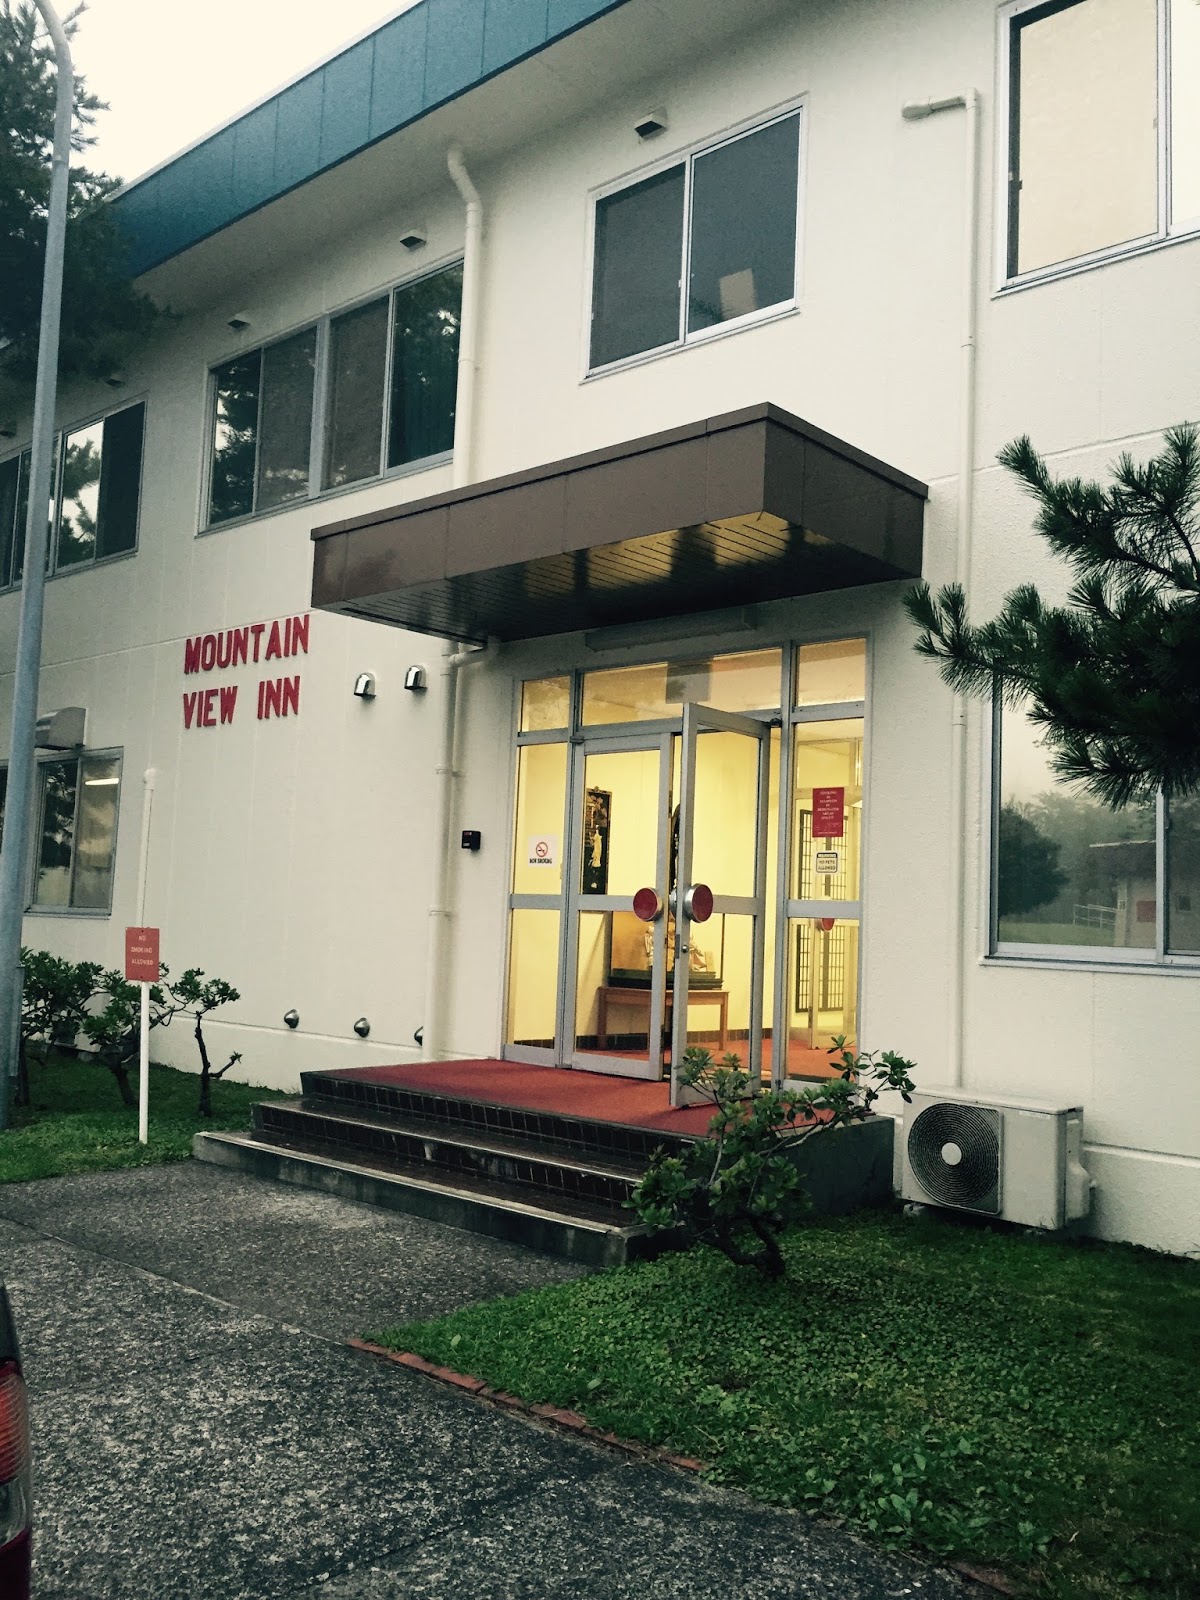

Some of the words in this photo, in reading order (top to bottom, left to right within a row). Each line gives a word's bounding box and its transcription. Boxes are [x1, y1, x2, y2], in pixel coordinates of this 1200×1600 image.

[184, 614, 310, 675] MOUNTAIN
[183, 685, 238, 729] VIEW
[257, 675, 301, 720] INN
[131, 958, 154, 966] ALLOWED
